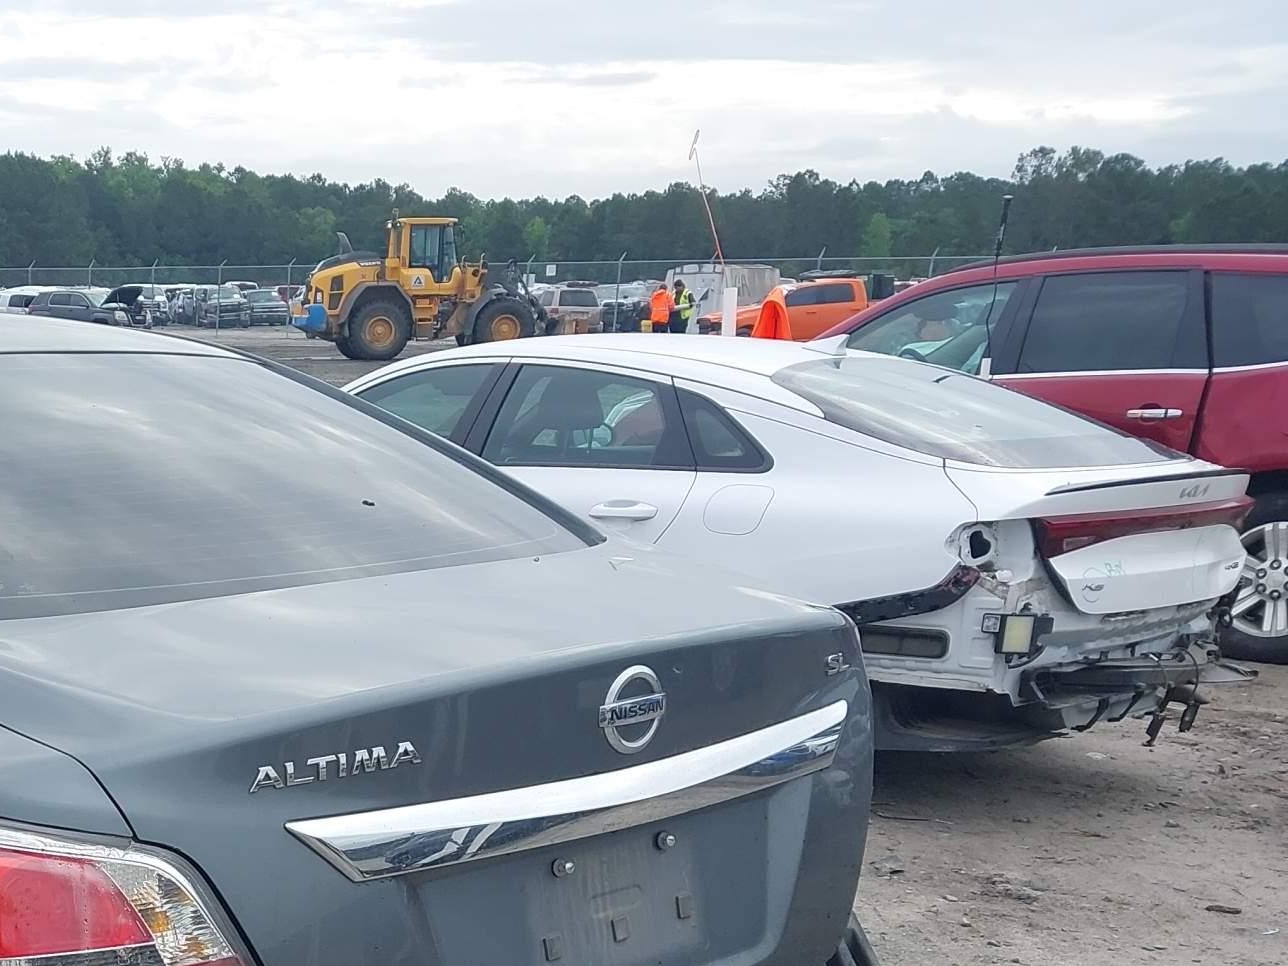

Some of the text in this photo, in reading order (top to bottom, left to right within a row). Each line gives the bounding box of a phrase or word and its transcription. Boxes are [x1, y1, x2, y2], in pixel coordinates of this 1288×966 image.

[827, 652, 851, 676] SL
[610, 698, 664, 721] NISSAN
[249, 741, 422, 793] ALTIMA
